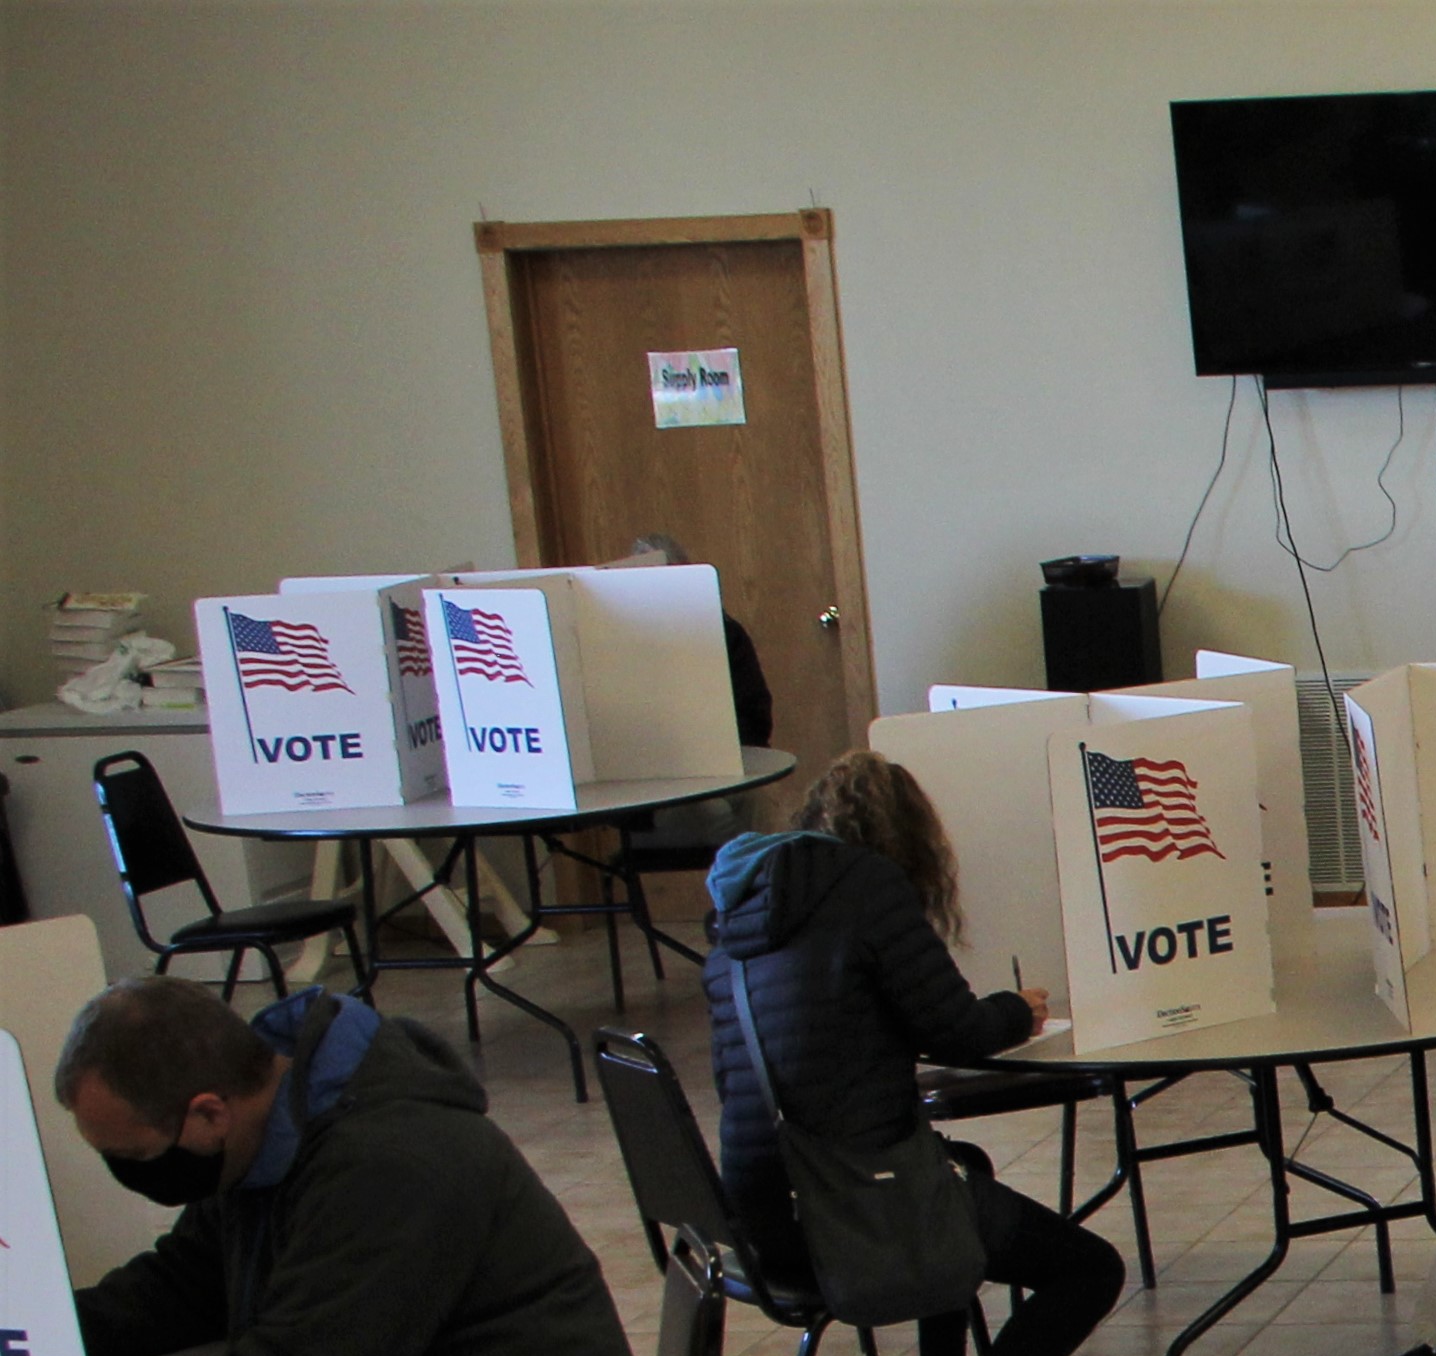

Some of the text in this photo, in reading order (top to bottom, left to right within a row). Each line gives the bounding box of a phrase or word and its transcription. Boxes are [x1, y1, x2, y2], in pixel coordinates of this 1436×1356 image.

[662, 366, 730, 391] Supply Room
[409, 714, 443, 749] VOTE
[470, 727, 542, 753] VOTE
[256, 733, 363, 763] VOTE
[1115, 914, 1234, 971] VOTE
